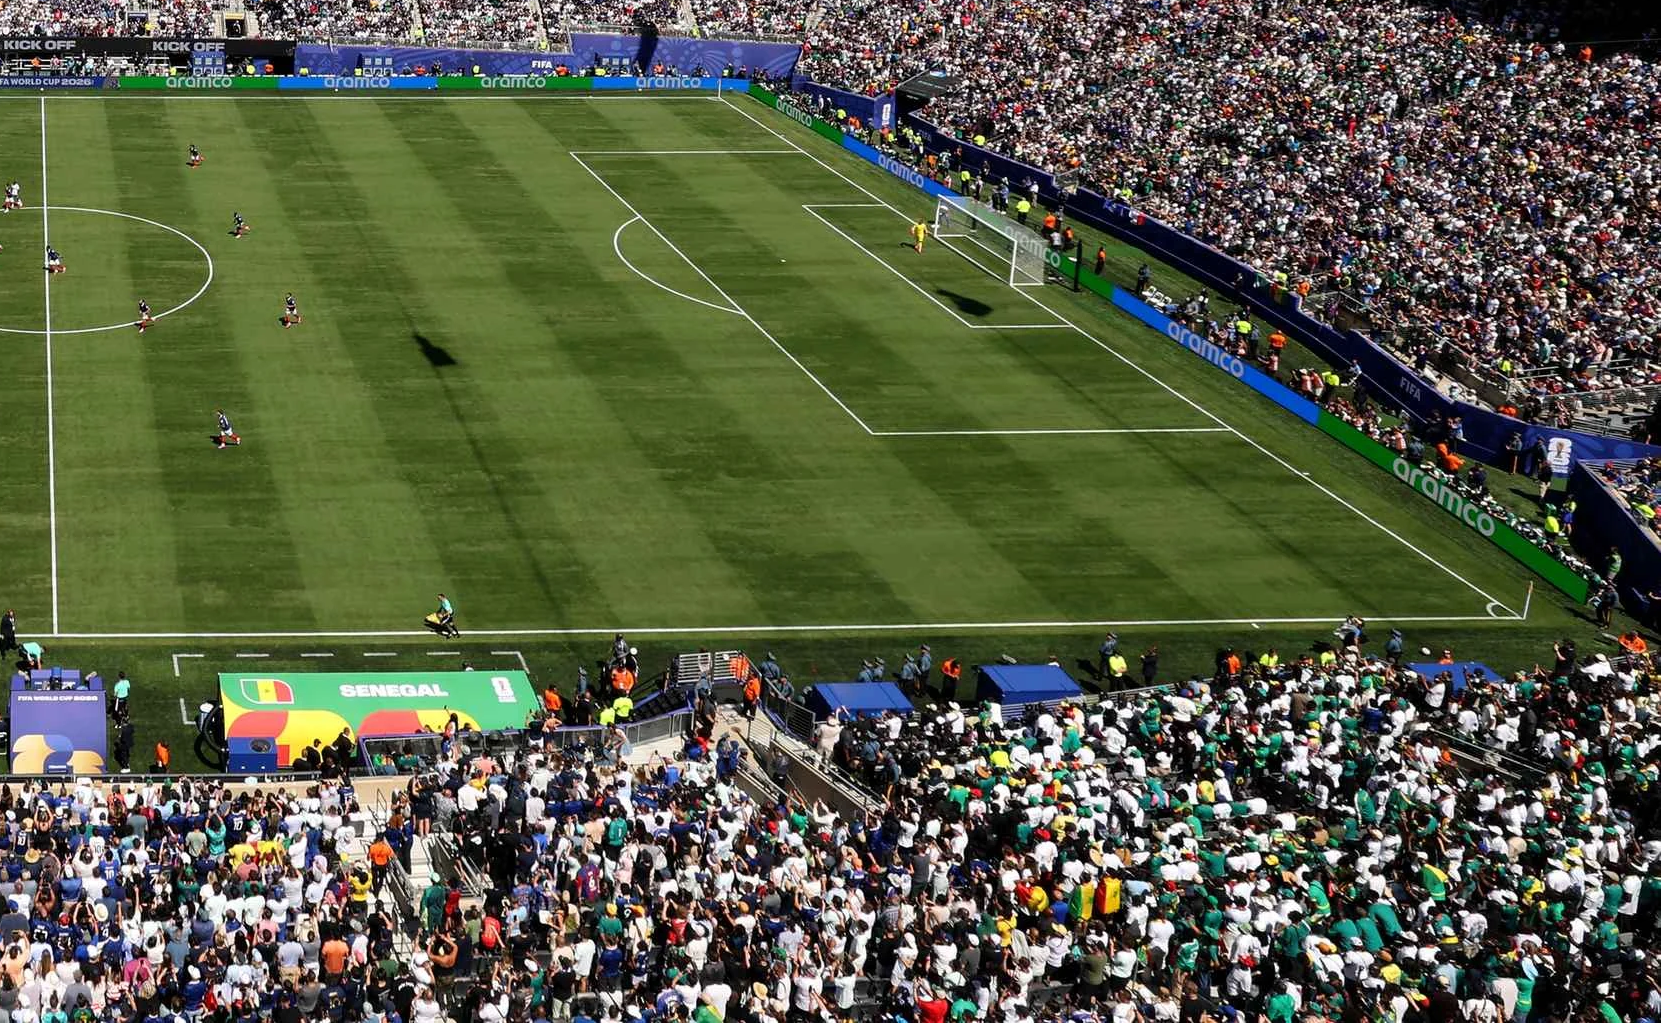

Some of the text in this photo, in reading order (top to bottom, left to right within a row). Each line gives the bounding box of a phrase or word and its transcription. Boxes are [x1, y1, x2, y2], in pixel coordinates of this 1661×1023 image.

[4, 40, 76, 50] KICK OFF
[152, 41, 226, 52] KICK OFF
[531, 60, 553, 69] FIFA
[10, 78, 42, 86] WORLD
[42, 78, 60, 86] CUP
[61, 78, 93, 86] 2026
[165, 75, 233, 88] aramco
[324, 76, 391, 89] aramco
[481, 76, 547, 89] aramco
[636, 76, 702, 89] aramco
[775, 96, 814, 128] aramco
[877, 153, 925, 189] aramco
[1167, 321, 1245, 378] aramco
[1399, 378, 1422, 402] FIFA
[1392, 455, 1496, 538] aramco
[339, 684, 450, 698] SENEGAL
[233, 821, 244, 831] 10
[105, 870, 115, 879] 10
